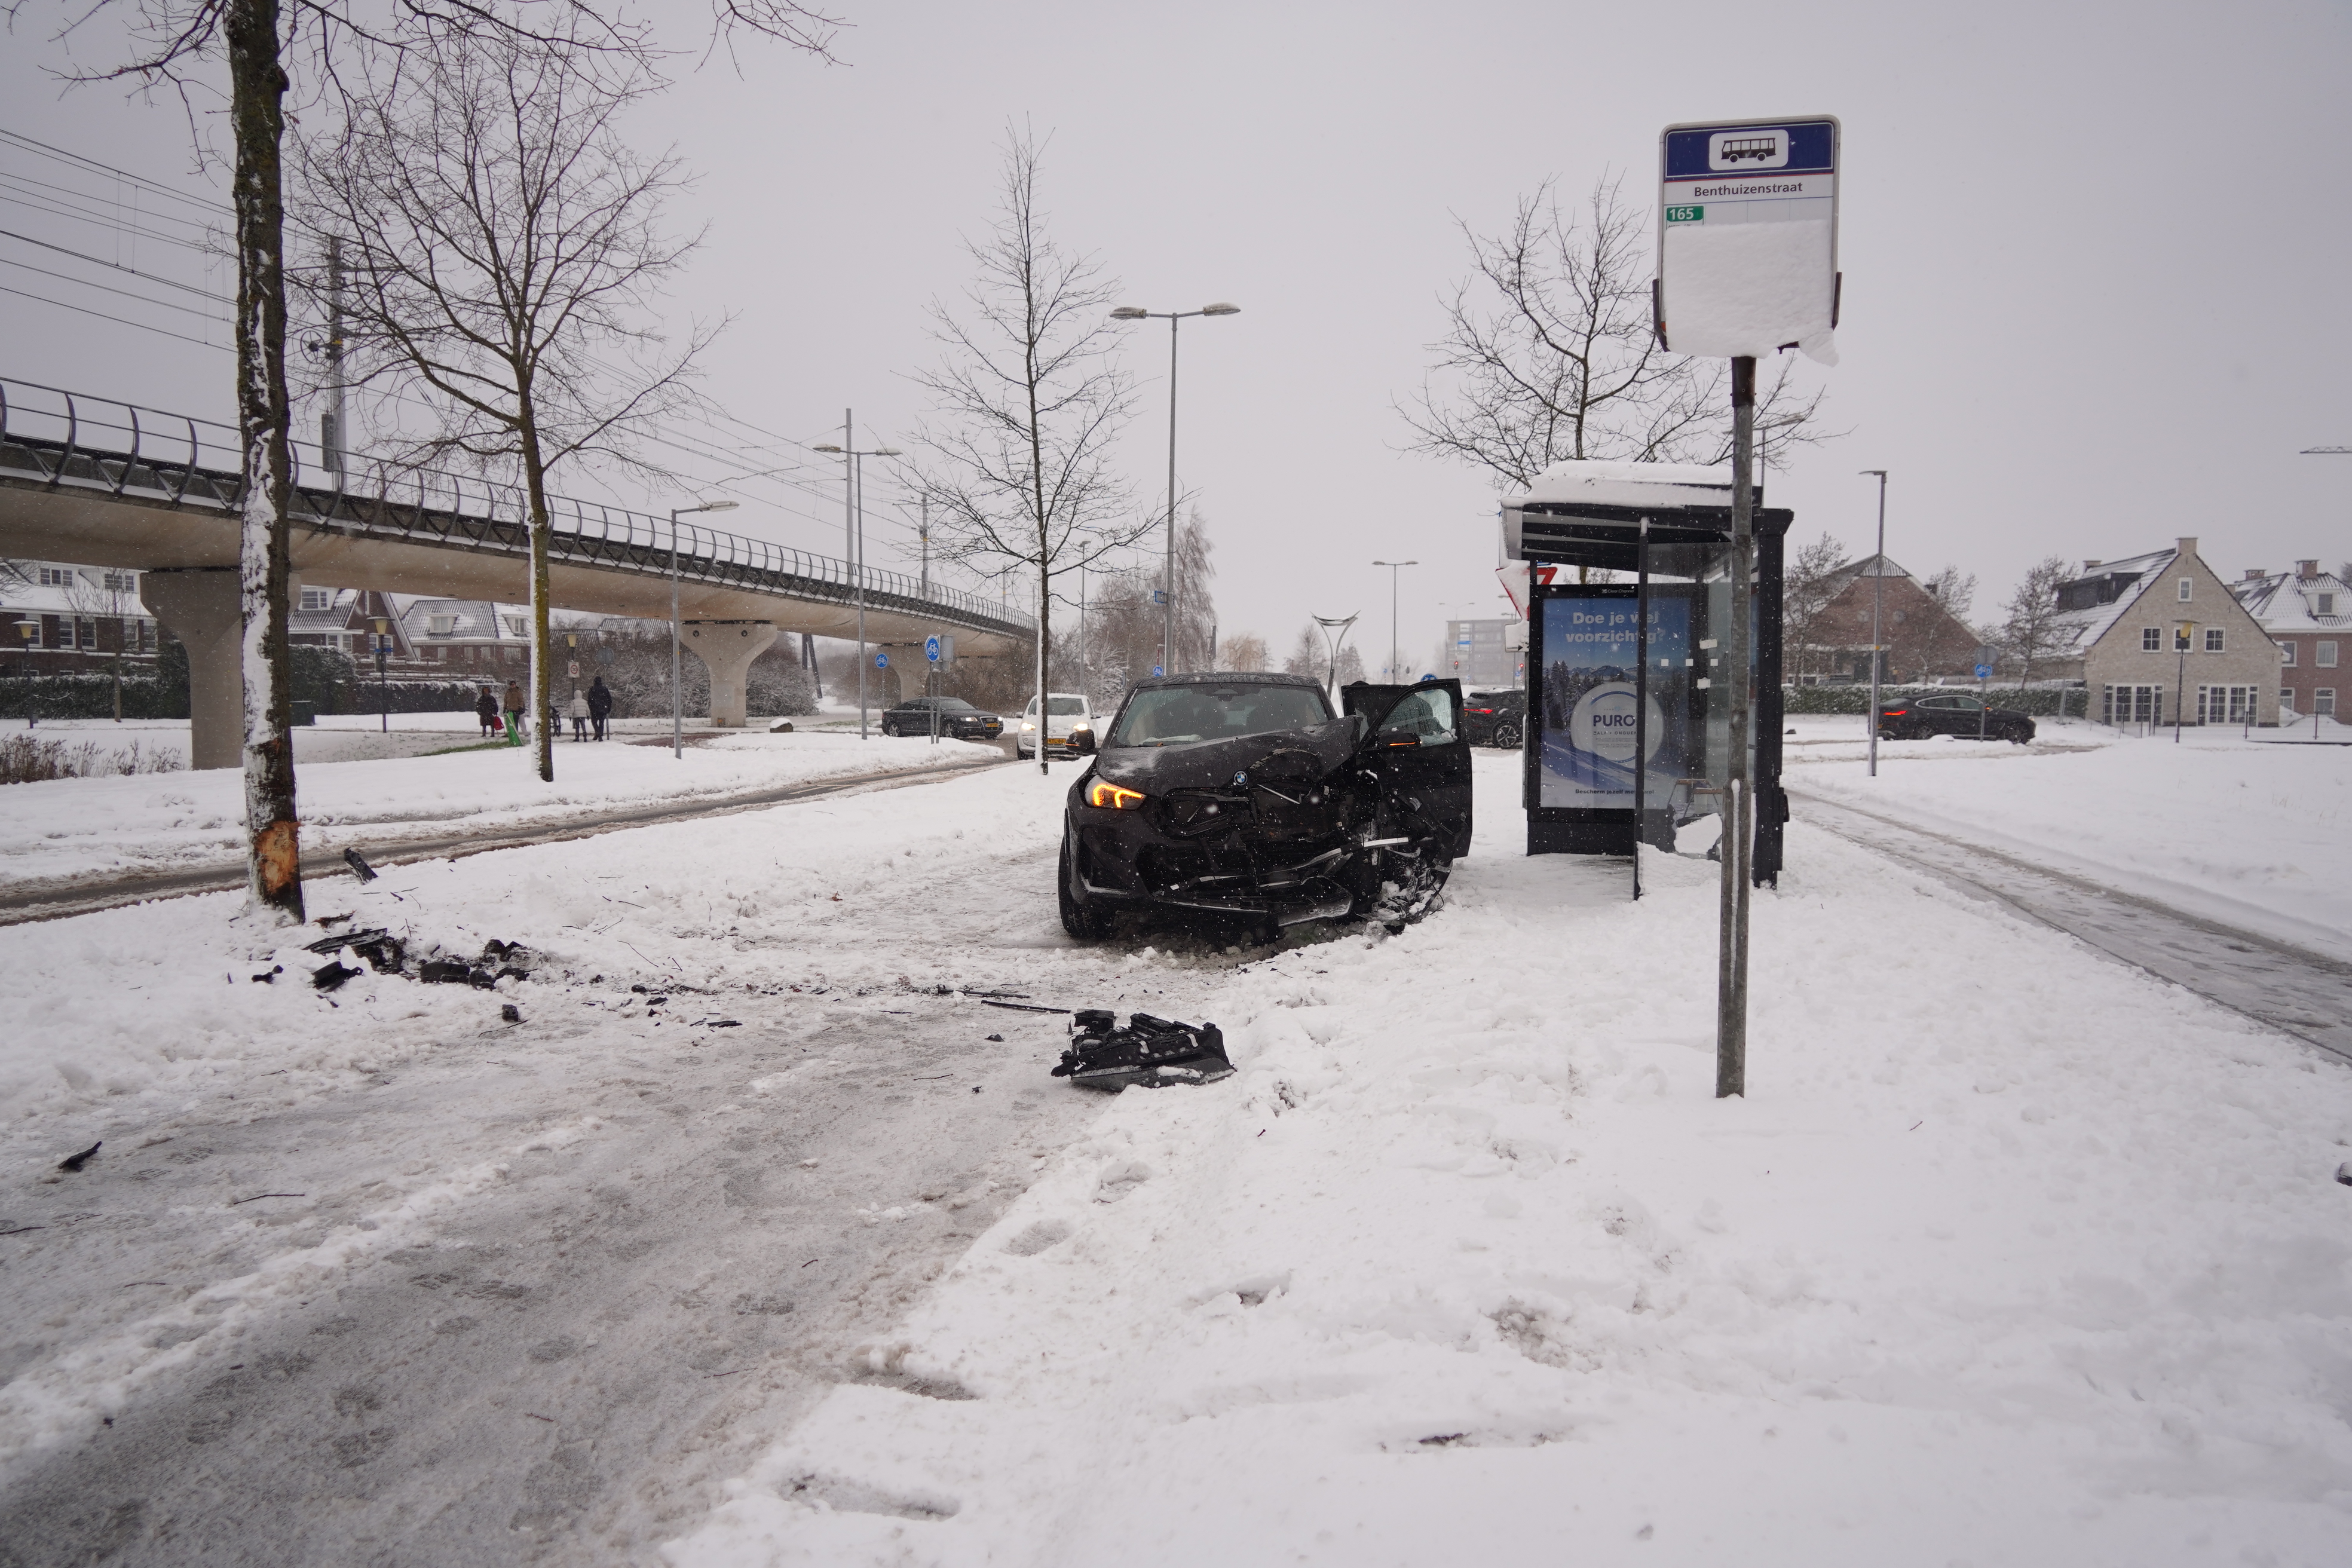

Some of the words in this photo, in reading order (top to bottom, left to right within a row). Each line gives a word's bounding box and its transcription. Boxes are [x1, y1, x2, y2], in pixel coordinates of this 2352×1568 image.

[1694, 182, 1803, 197] Benthuizenstraat
[1670, 208, 1694, 220] 165
[1573, 612, 1604, 624] Doe
[1609, 612, 1625, 626] je
[1566, 629, 1665, 644] voorzichtg?
[1593, 714, 1636, 727] PURO
